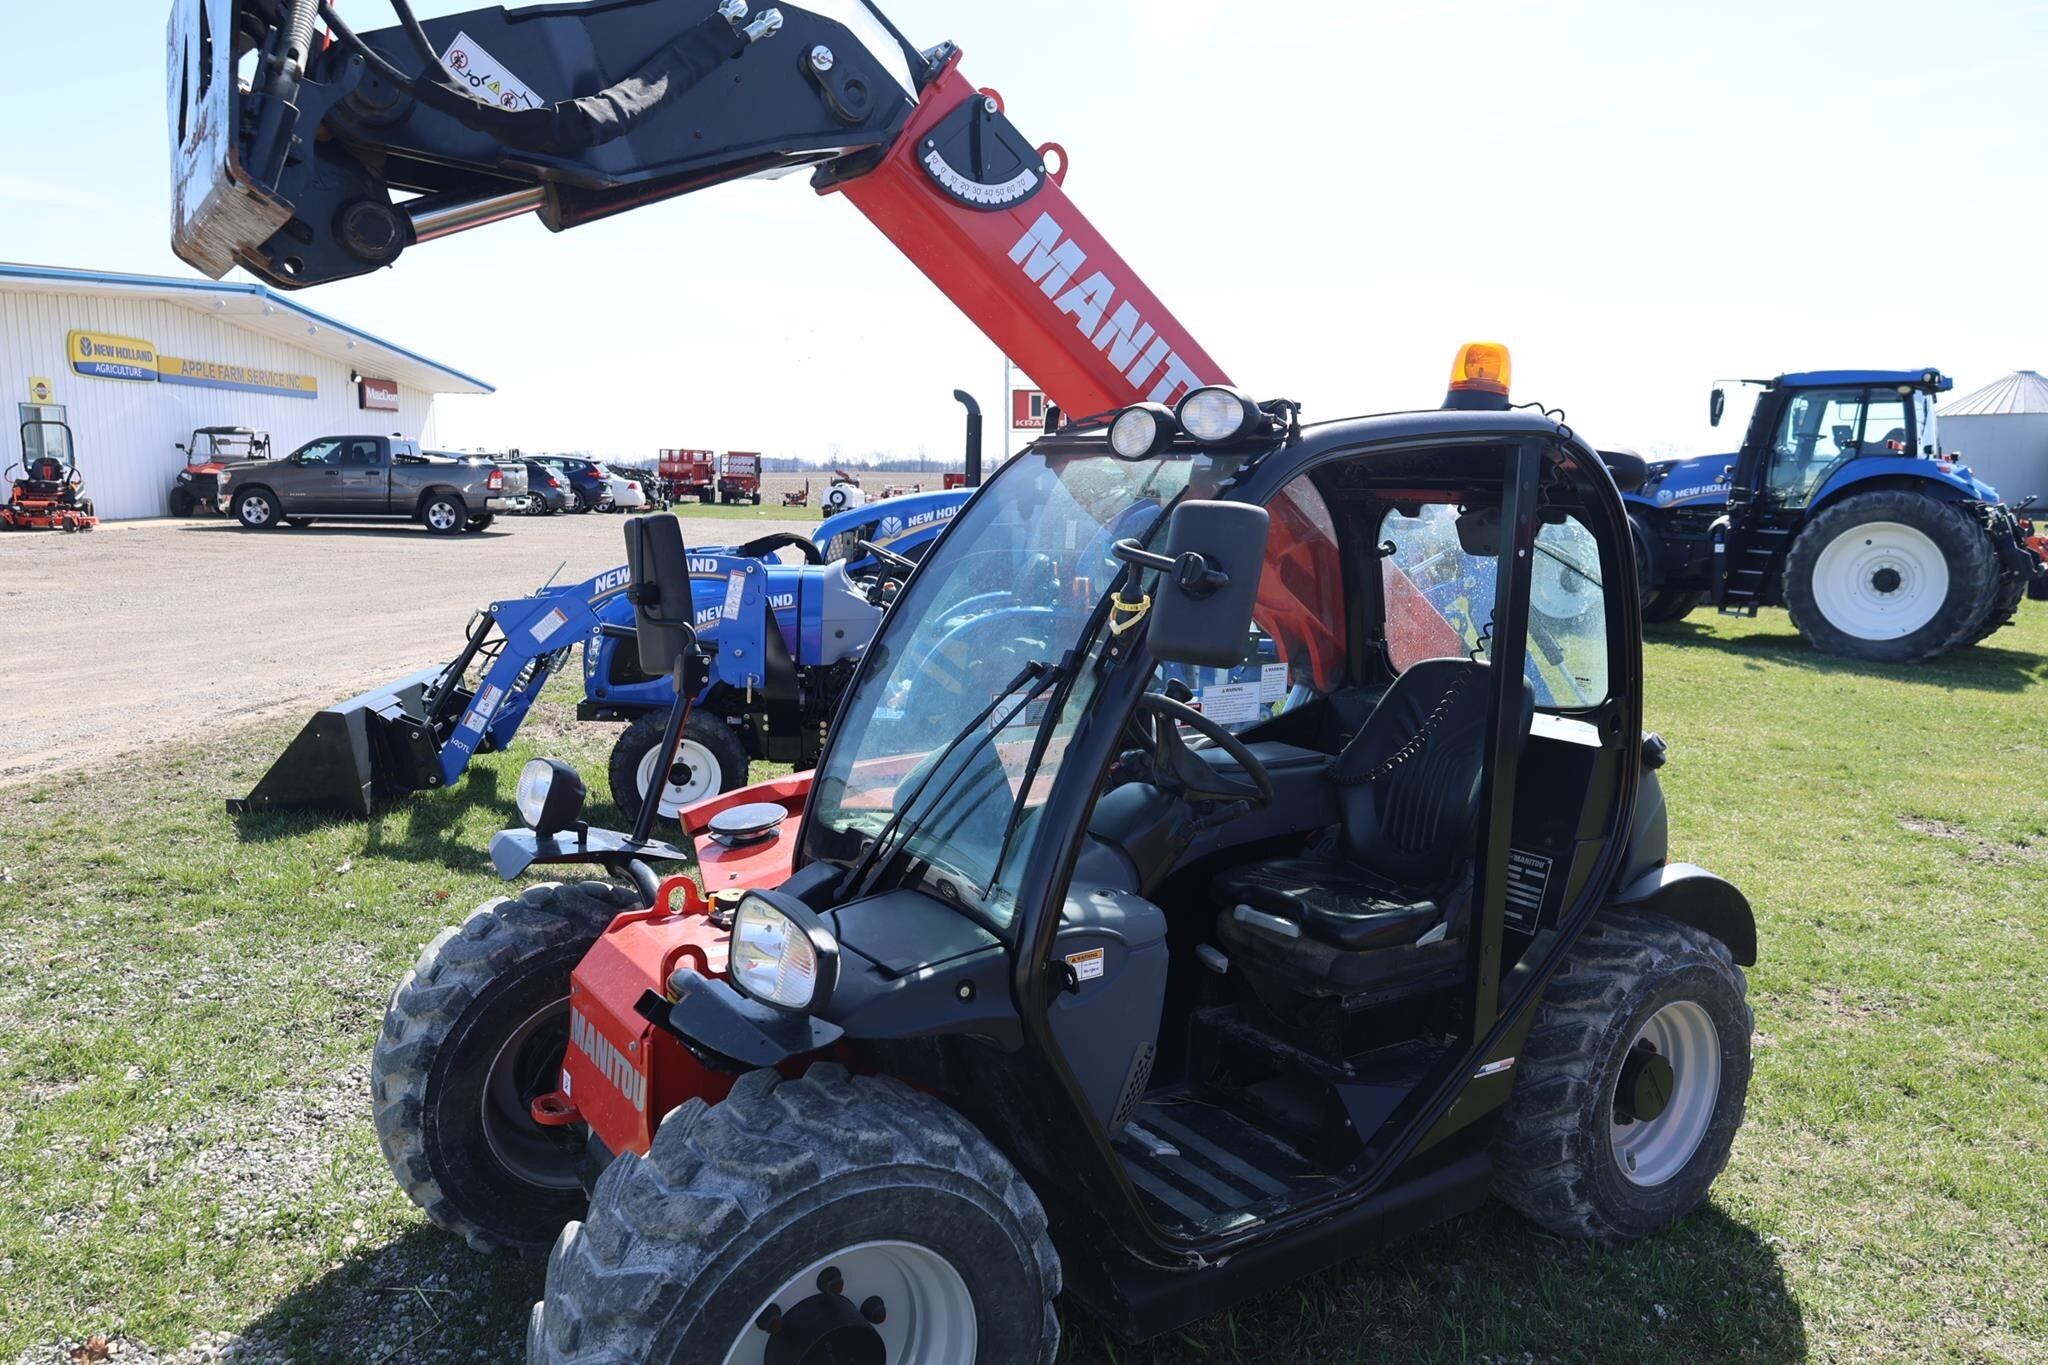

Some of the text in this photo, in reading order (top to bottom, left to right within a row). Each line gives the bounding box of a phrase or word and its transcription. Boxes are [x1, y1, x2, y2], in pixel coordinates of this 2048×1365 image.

[1008, 212, 1206, 407] MANIT
[94, 344, 153, 362] NEW HOLLAND
[95, 363, 143, 377] AGRICULTURE
[181, 361, 216, 379] APPLE
[217, 365, 245, 383] FARM
[247, 367, 285, 387] SERVICE
[1675, 486, 1701, 499] NEW
[908, 511, 935, 528] NEW
[594, 567, 632, 595] NEW
[1513, 854, 1545, 869] MANITOU
[570, 1006, 647, 1113] MANITOU
